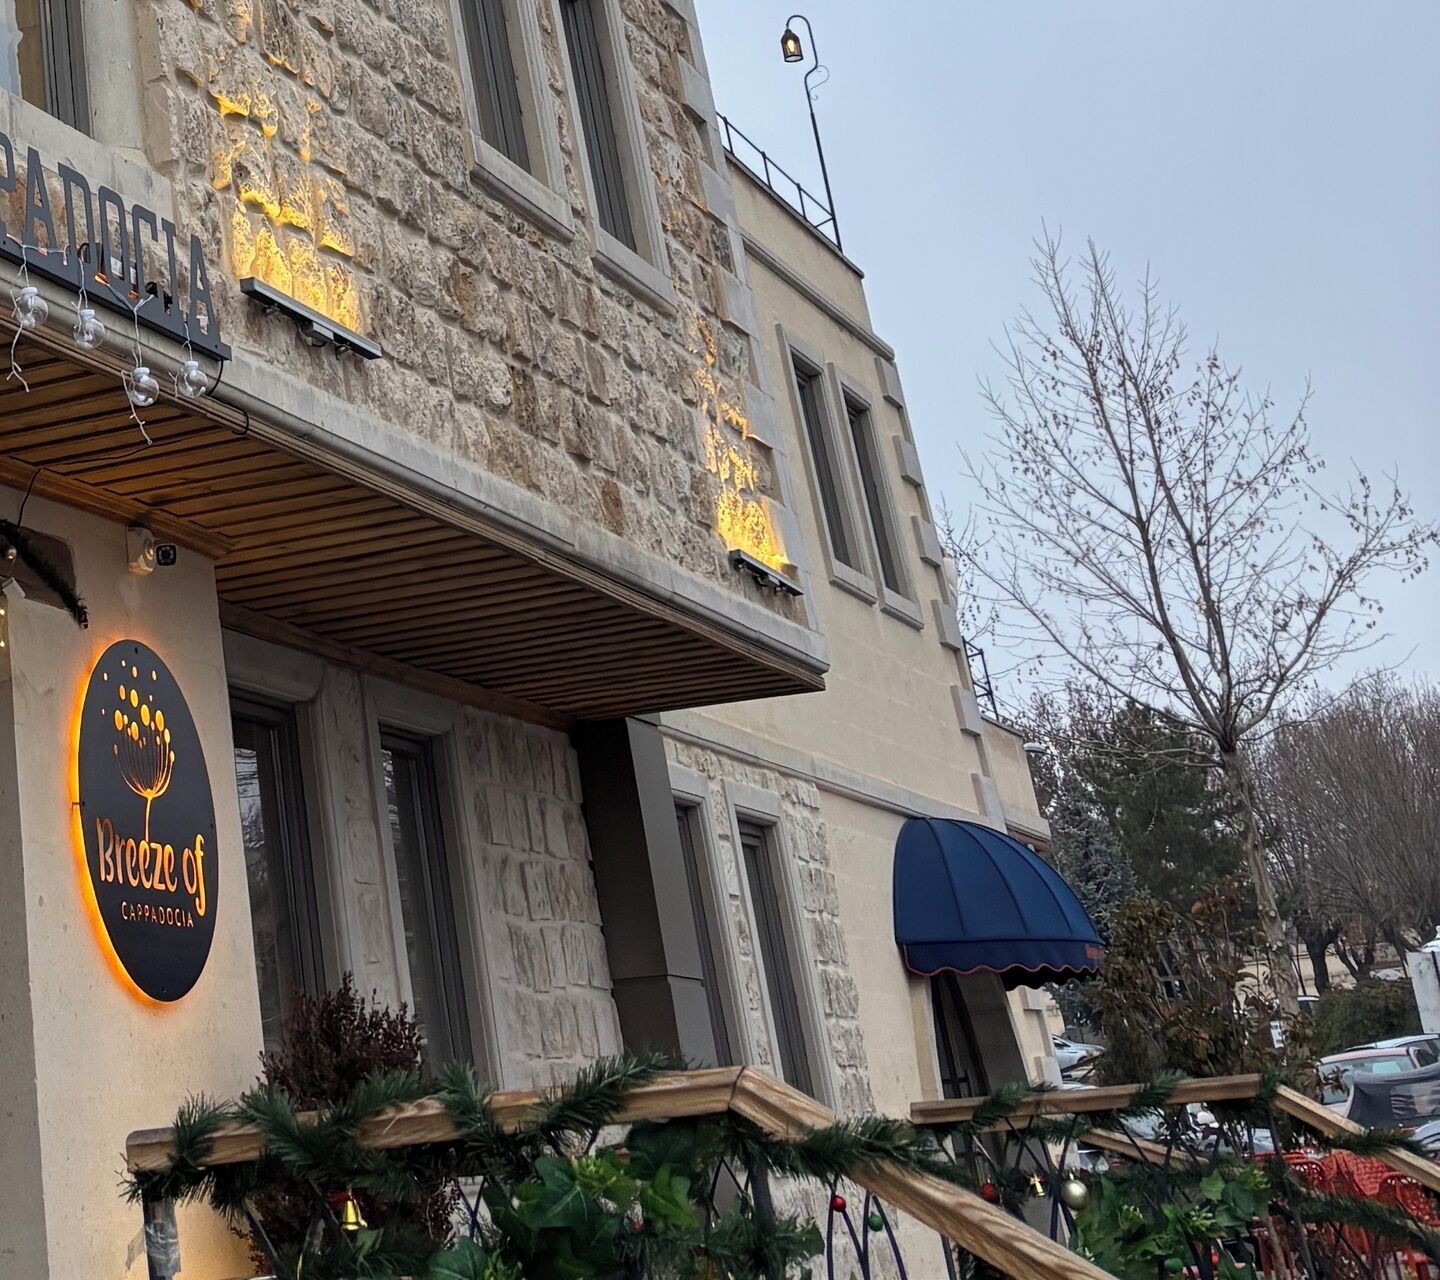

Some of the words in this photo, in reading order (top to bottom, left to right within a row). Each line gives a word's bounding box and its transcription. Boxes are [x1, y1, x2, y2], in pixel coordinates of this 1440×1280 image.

[95, 817, 178, 893] Breeze
[182, 833, 206, 917] of
[121, 901, 195, 928] CAPPADOCIA
